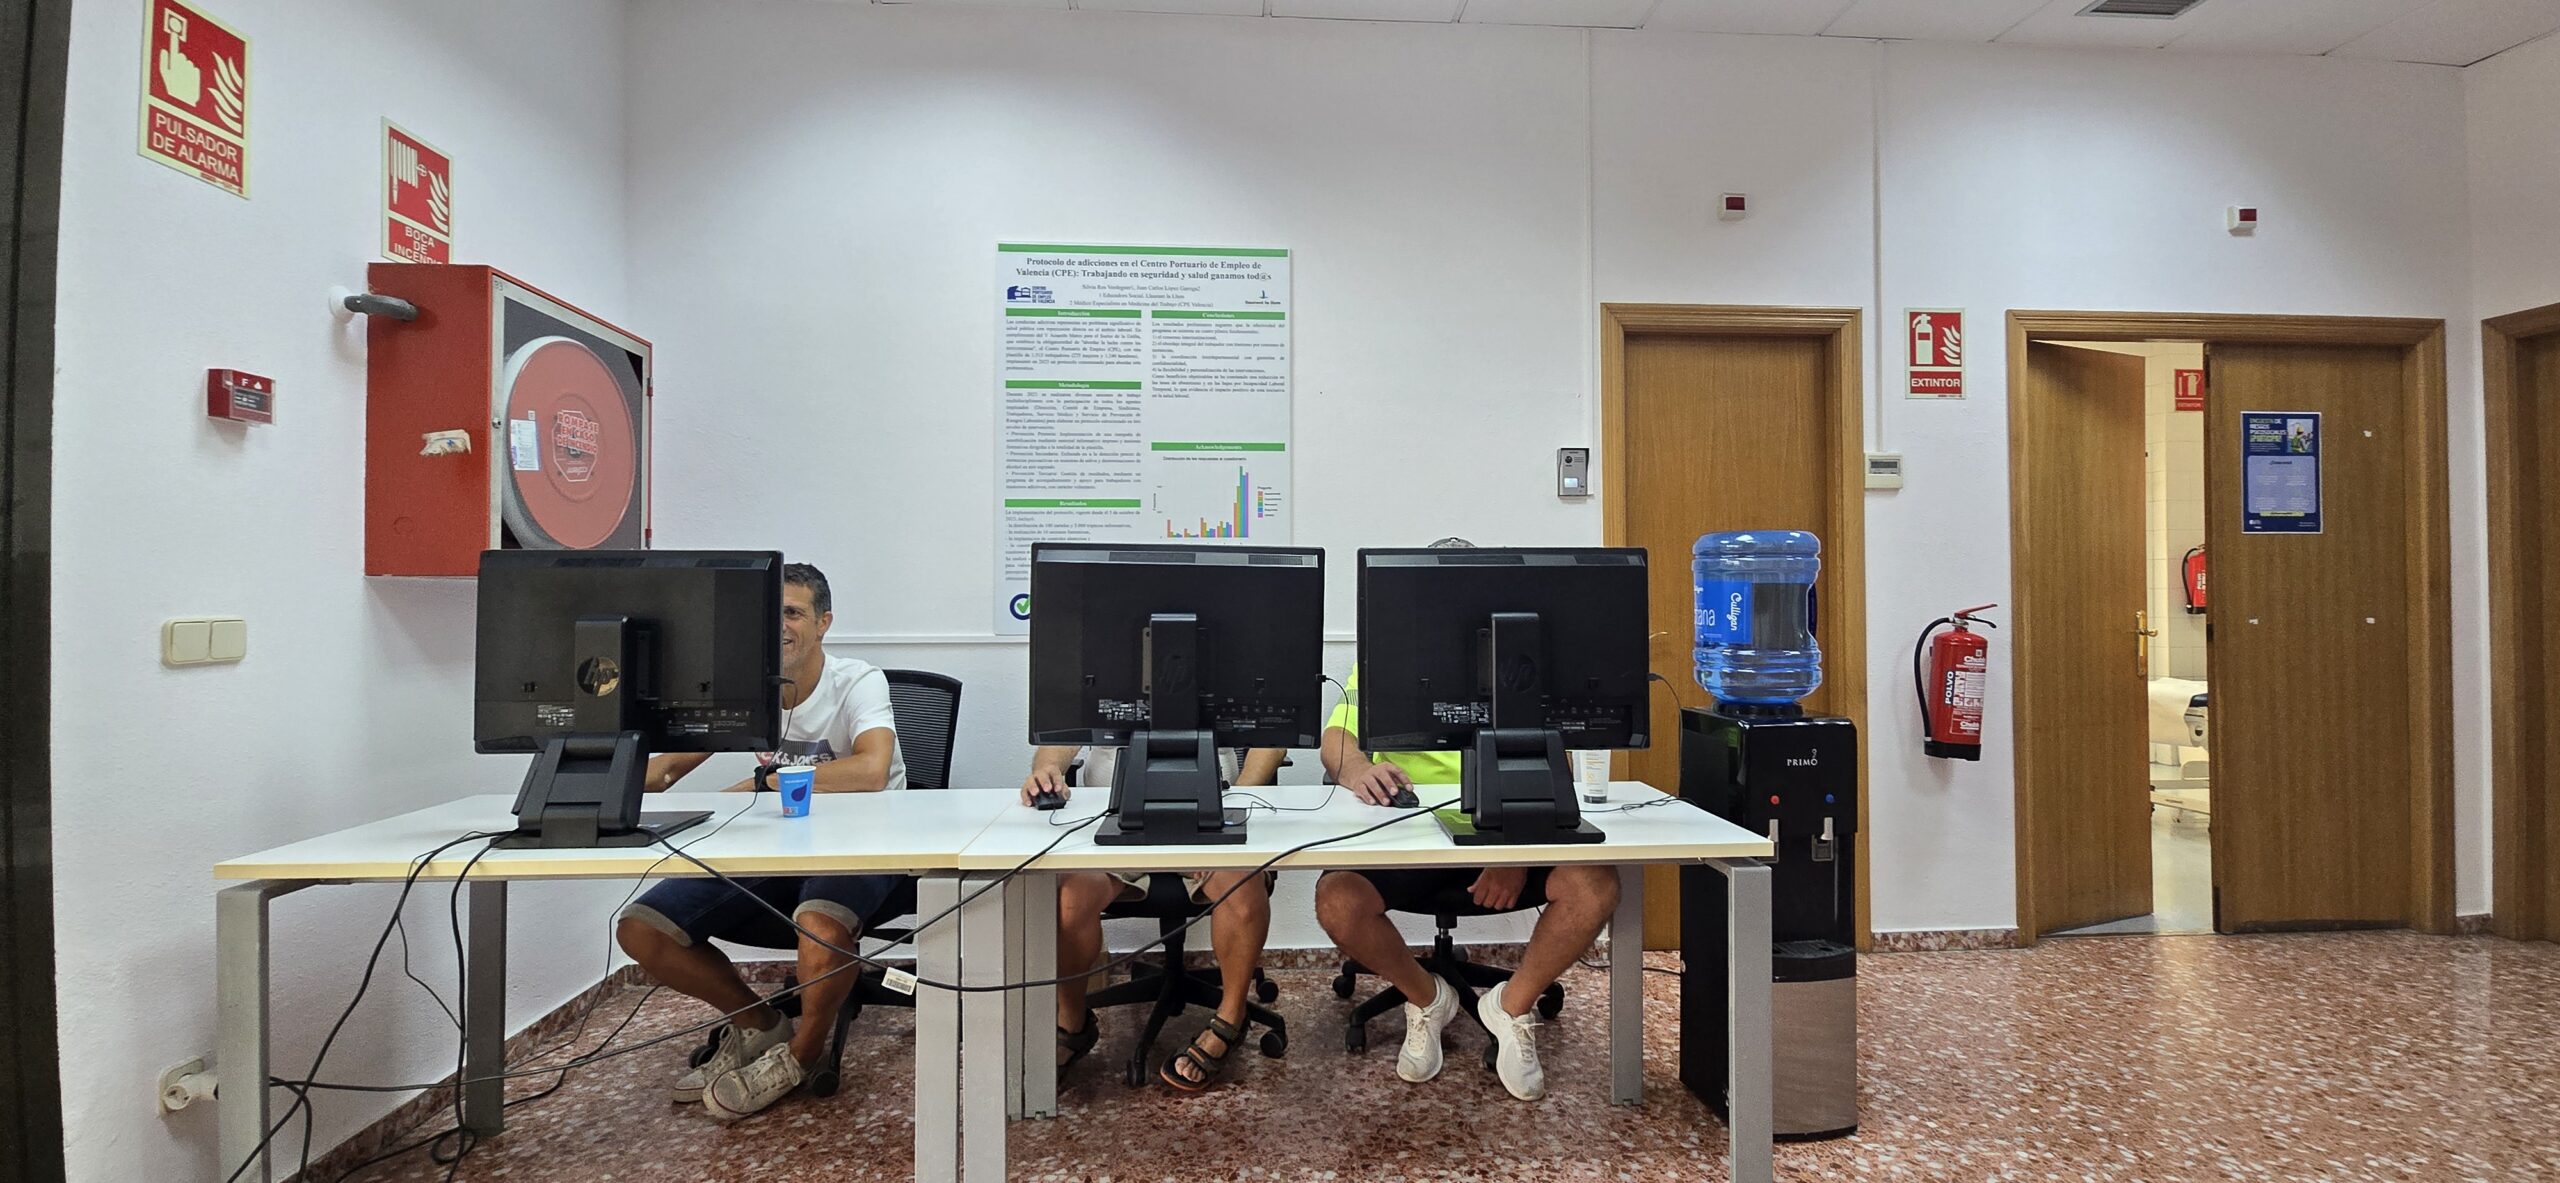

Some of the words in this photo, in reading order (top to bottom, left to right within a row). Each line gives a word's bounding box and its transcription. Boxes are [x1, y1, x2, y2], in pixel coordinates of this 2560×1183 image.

[156, 113, 238, 163] PULSADOR
[153, 132, 176, 154] DE
[178, 144, 240, 182] ALARMA
[405, 226, 435, 248] BOCA
[413, 241, 428, 254] DE
[394, 243, 443, 264] INCEND
[1052, 269, 1079, 278] (CPE):
[1081, 270, 1127, 279] Trabajando
[1140, 271, 1179, 279] seguridad
[1247, 272, 1272, 281] tod@s
[1221, 261, 1250, 270] Empleo
[1911, 378, 1960, 387] EXTINTOR
[557, 412, 599, 434] ROMPASE
[1726, 592, 1742, 630] Culligan
[1945, 671, 1954, 704] POLVO
